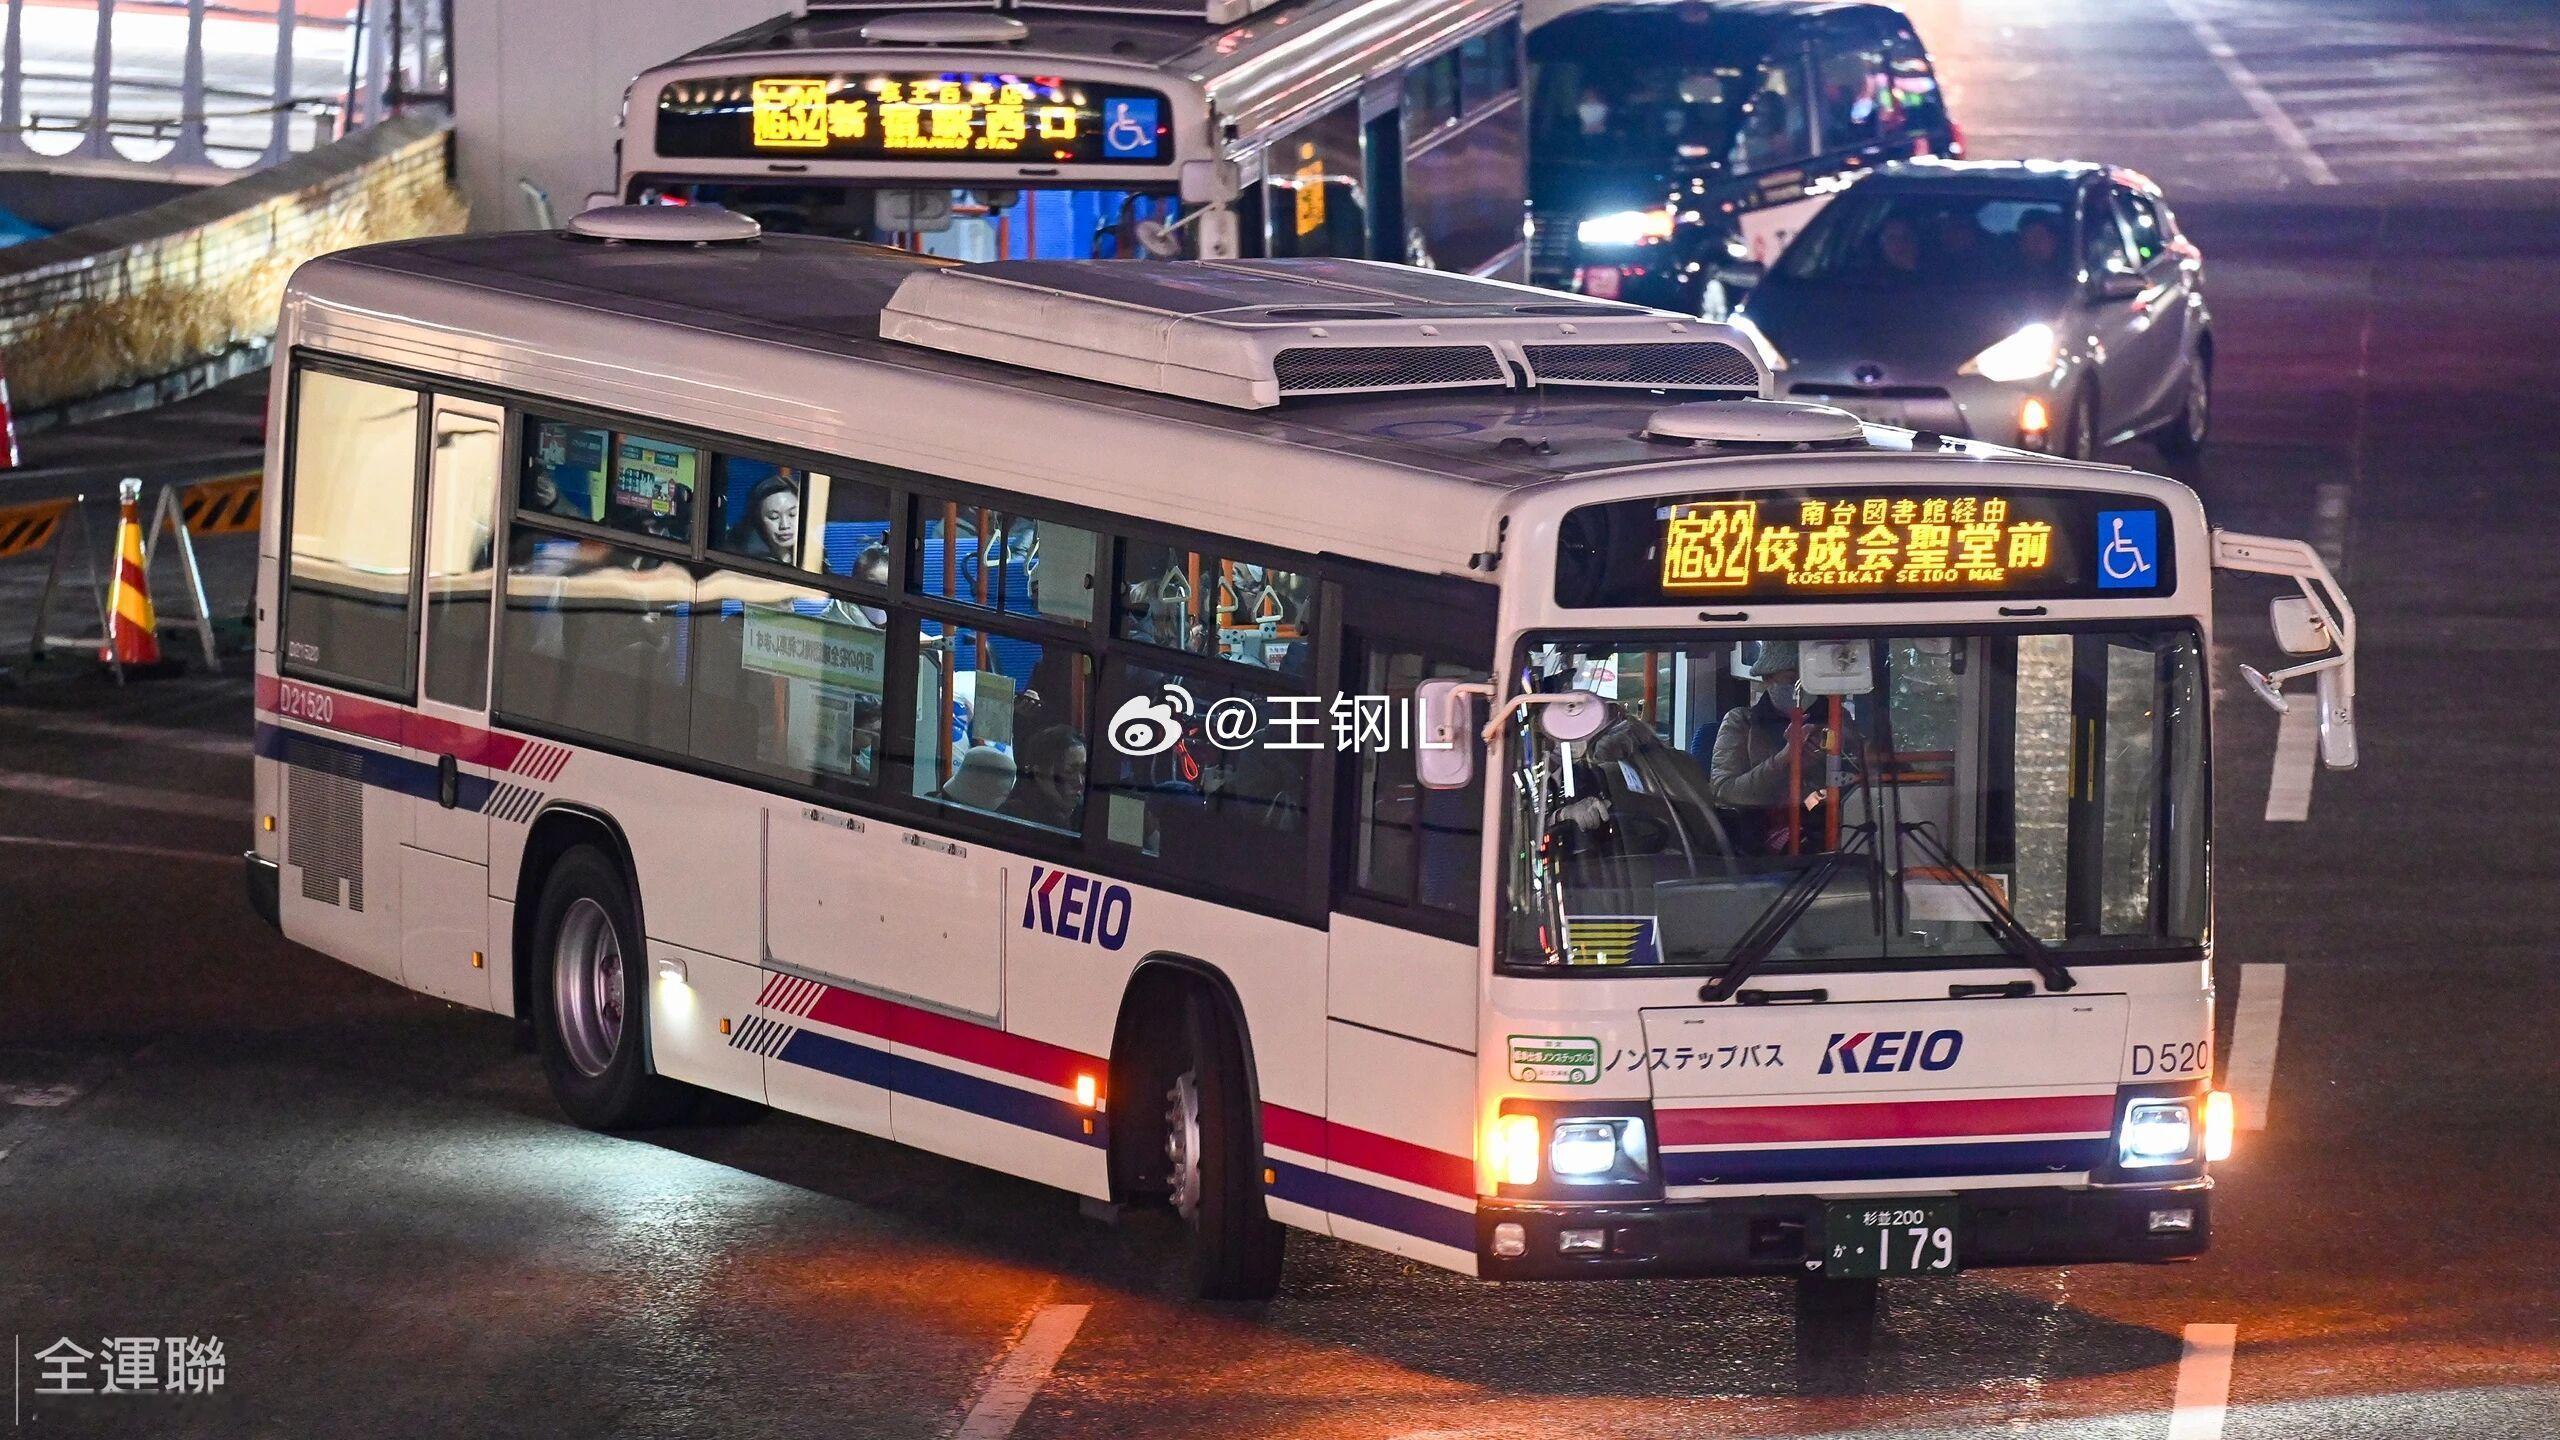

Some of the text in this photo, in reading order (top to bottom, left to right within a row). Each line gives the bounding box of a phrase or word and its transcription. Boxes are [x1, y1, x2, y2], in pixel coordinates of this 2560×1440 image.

[1801, 497, 2008, 526] 南台図書館経由
[1668, 509, 1751, 580] 宿32
[1754, 521, 2052, 573] 佼成会聖堂前
[1786, 567, 2006, 585] KOSEIKAI SEIDO MAE
[280, 684, 334, 723] D21520
[1022, 865, 1133, 952] KEIO
[1605, 1044, 1785, 1072] ノンステップバス
[1817, 1028, 1964, 1075] KEIO
[2132, 1040, 2209, 1075] D520
